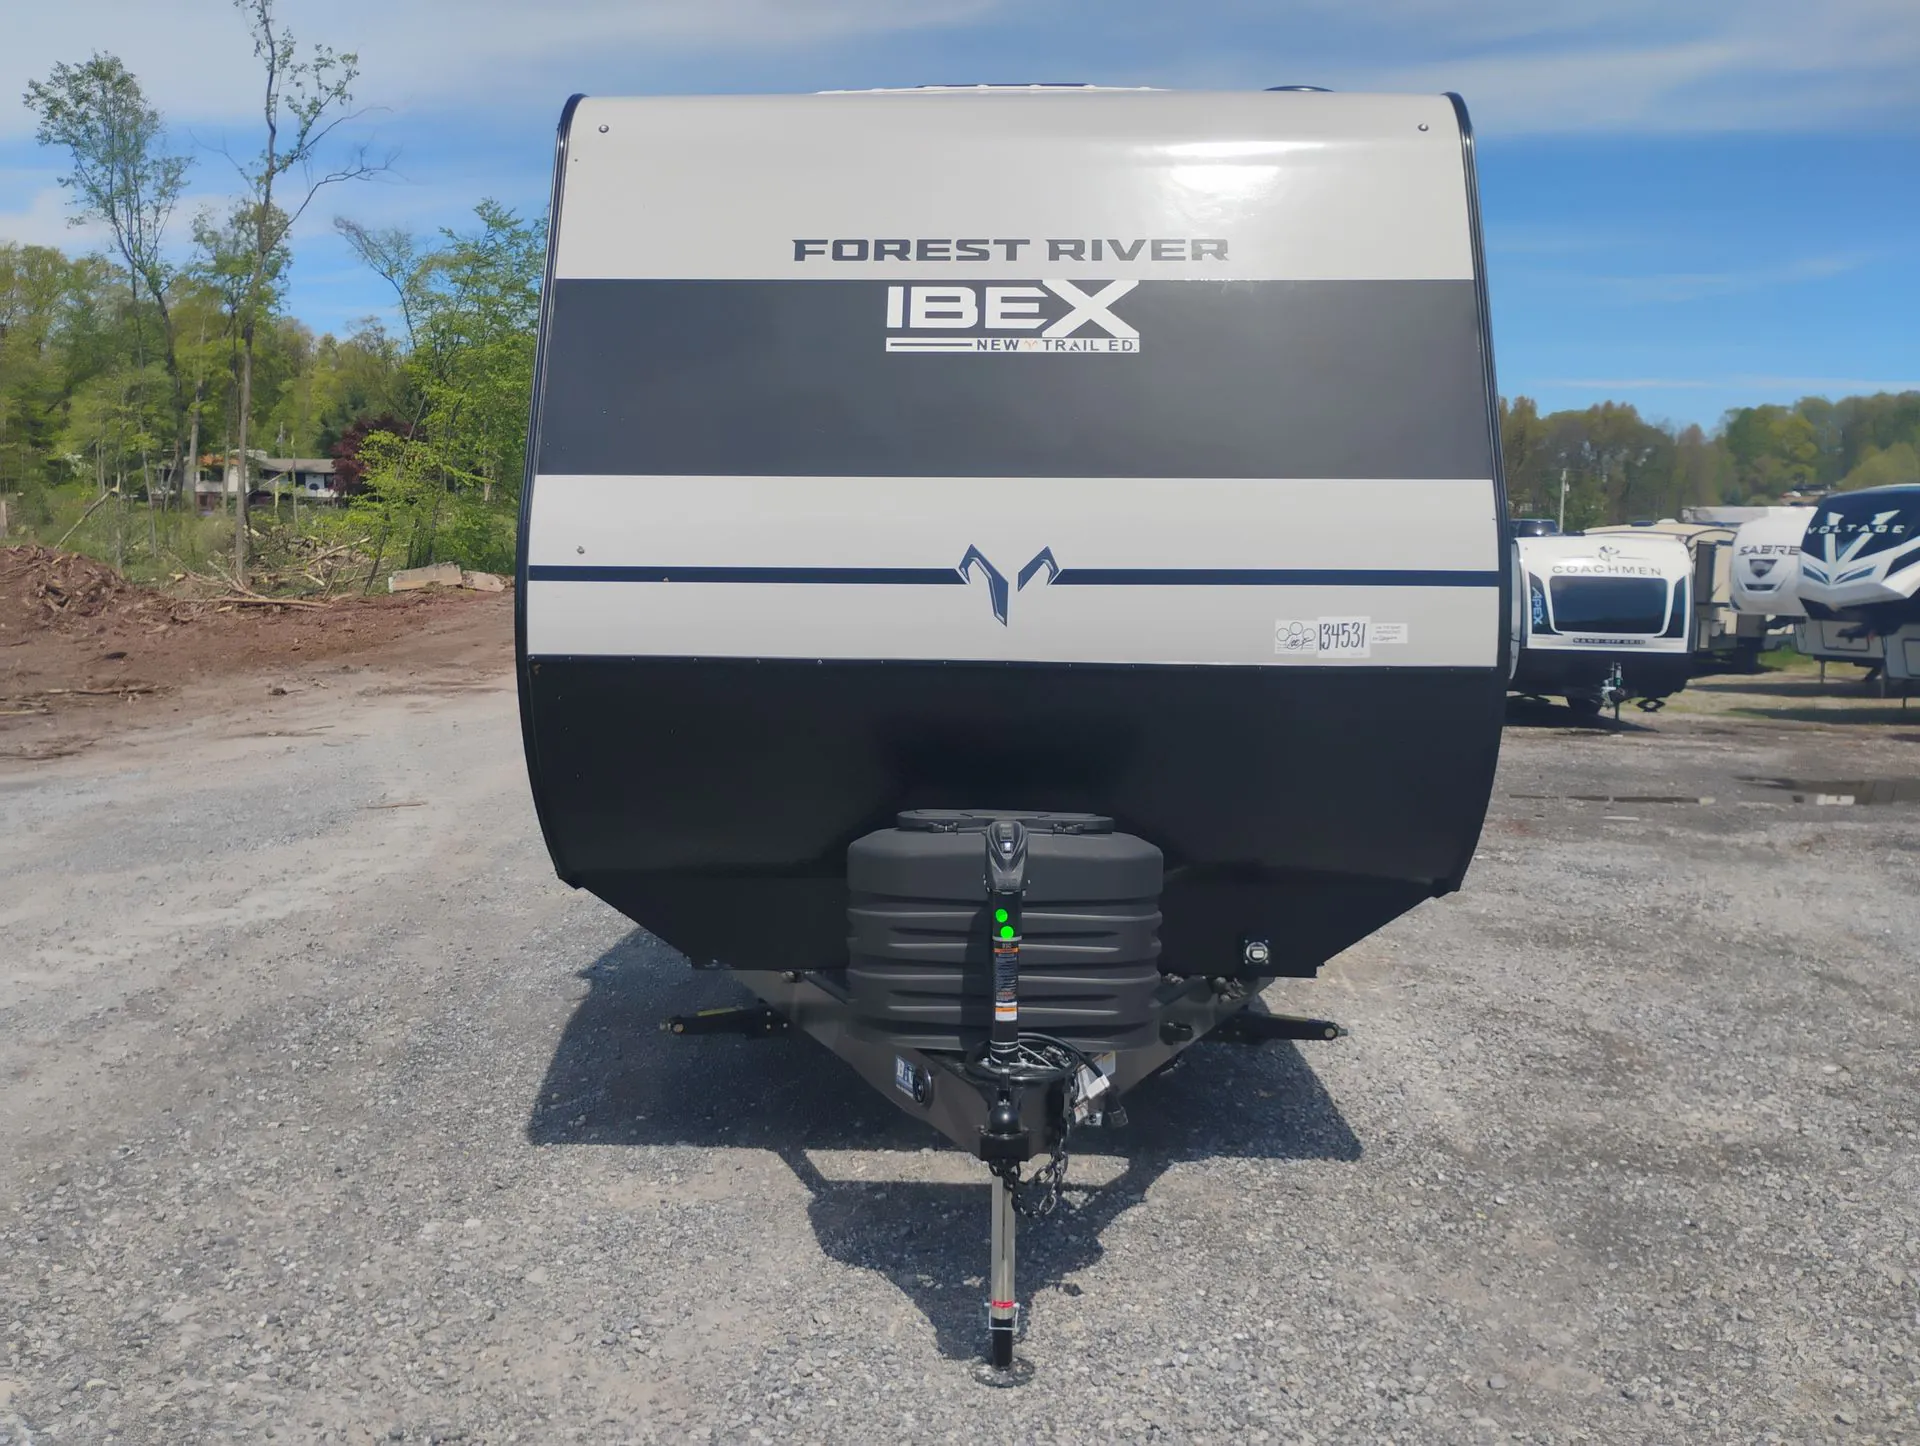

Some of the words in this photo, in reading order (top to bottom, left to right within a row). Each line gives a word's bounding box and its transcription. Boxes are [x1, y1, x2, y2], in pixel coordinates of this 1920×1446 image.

[791, 239, 1030, 262] FOREST
[1046, 239, 1229, 262] RIVER
[886, 279, 1140, 338] IBEX
[976, 339, 1020, 351] NEW
[1042, 339, 1100, 351] TRAIL
[1108, 339, 1137, 352] ED.
[1807, 524, 1906, 535] VOLTAGE
[1739, 544, 1801, 557] SABRE
[1552, 564, 1662, 576] COACHMEN
[1531, 586, 1544, 625] APEX
